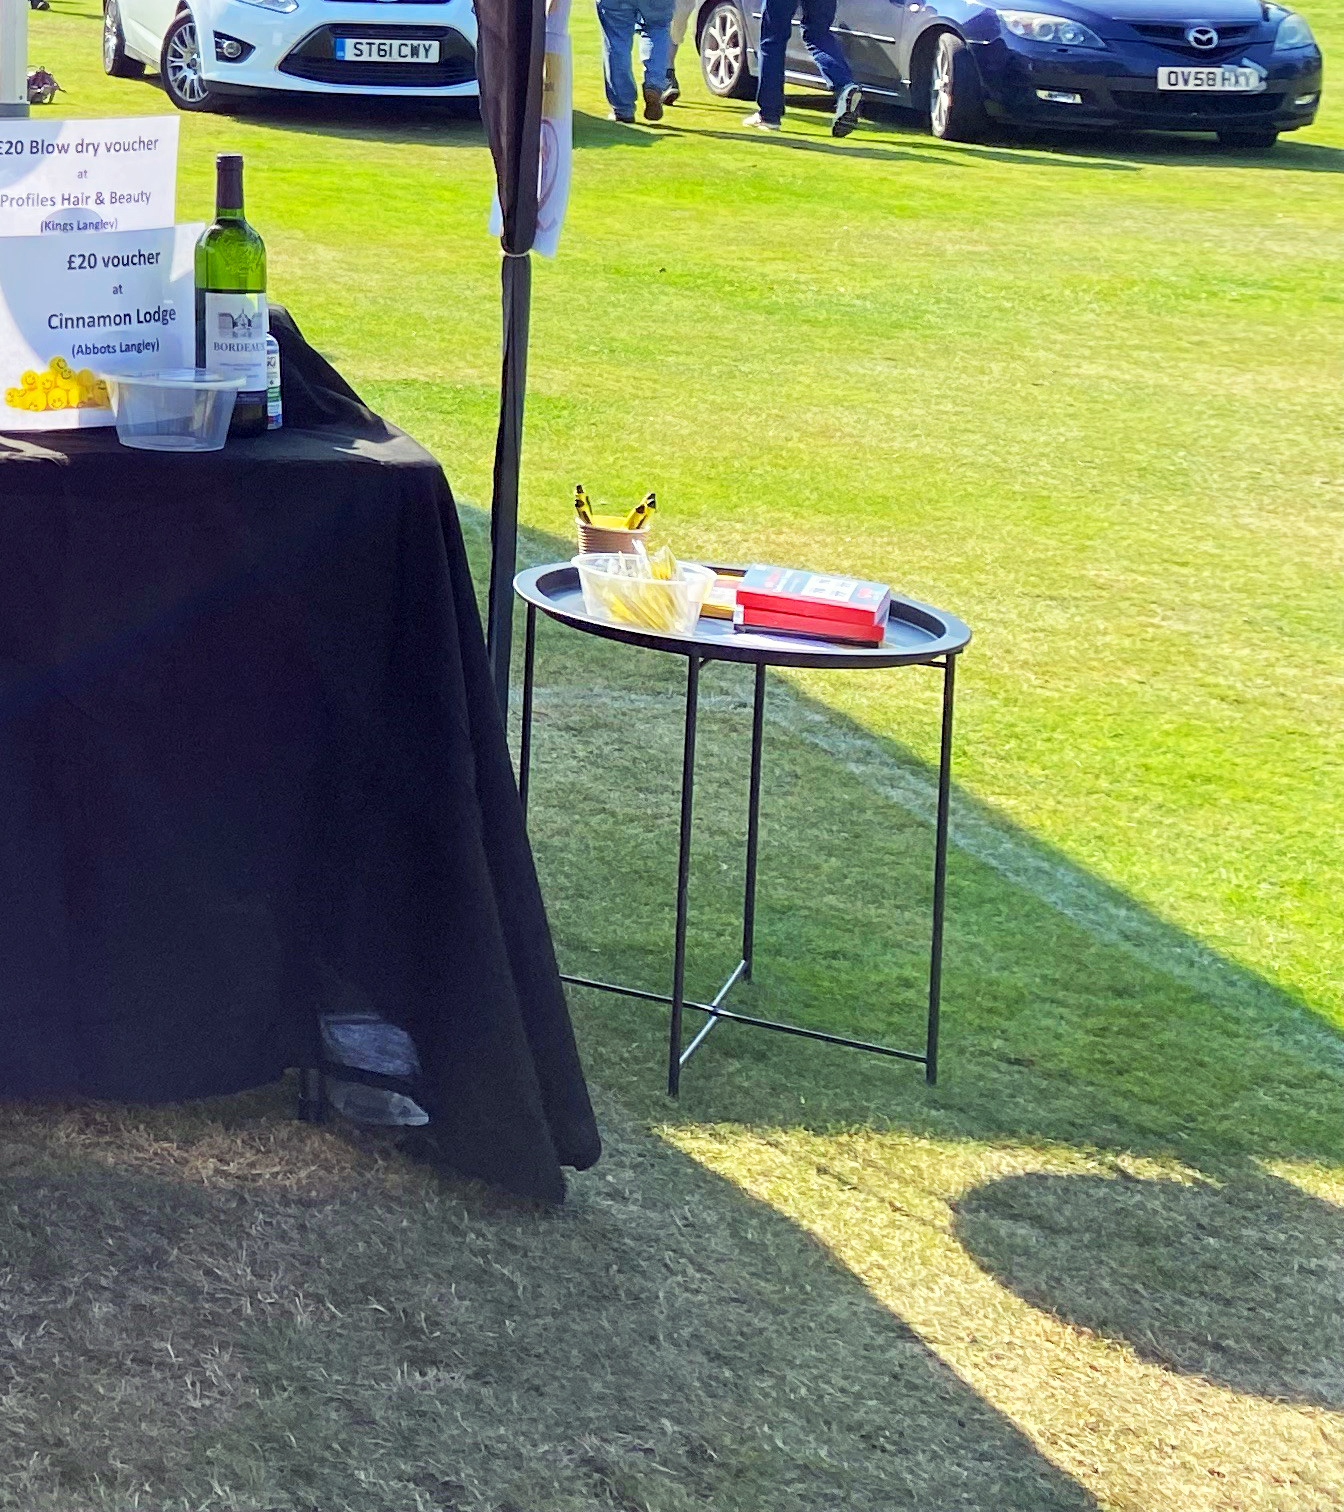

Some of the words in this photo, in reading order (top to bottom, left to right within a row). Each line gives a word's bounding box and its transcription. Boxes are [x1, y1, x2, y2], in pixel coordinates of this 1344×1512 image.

[353, 41, 393, 57] ST61
[398, 43, 432, 59] CWY
[1168, 71, 1217, 87] OV58
[29, 138, 70, 155] Blow
[75, 138, 100, 157] dry
[104, 136, 159, 154] voucher
[77, 169, 88, 180] at
[0, 192, 56, 208] Profiles
[61, 191, 91, 207] Hair
[95, 191, 106, 206] &
[109, 190, 152, 208] Beauty
[40, 219, 73, 234] (Kings
[76, 217, 119, 234] Langley)
[67, 253, 97, 271] £20
[101, 249, 161, 268] voucher
[112, 284, 123, 296] at
[47, 309, 132, 330] Cinnamon
[136, 305, 177, 326] Lodge
[71, 342, 117, 359] (Abbots
[119, 338, 161, 357] Langley)
